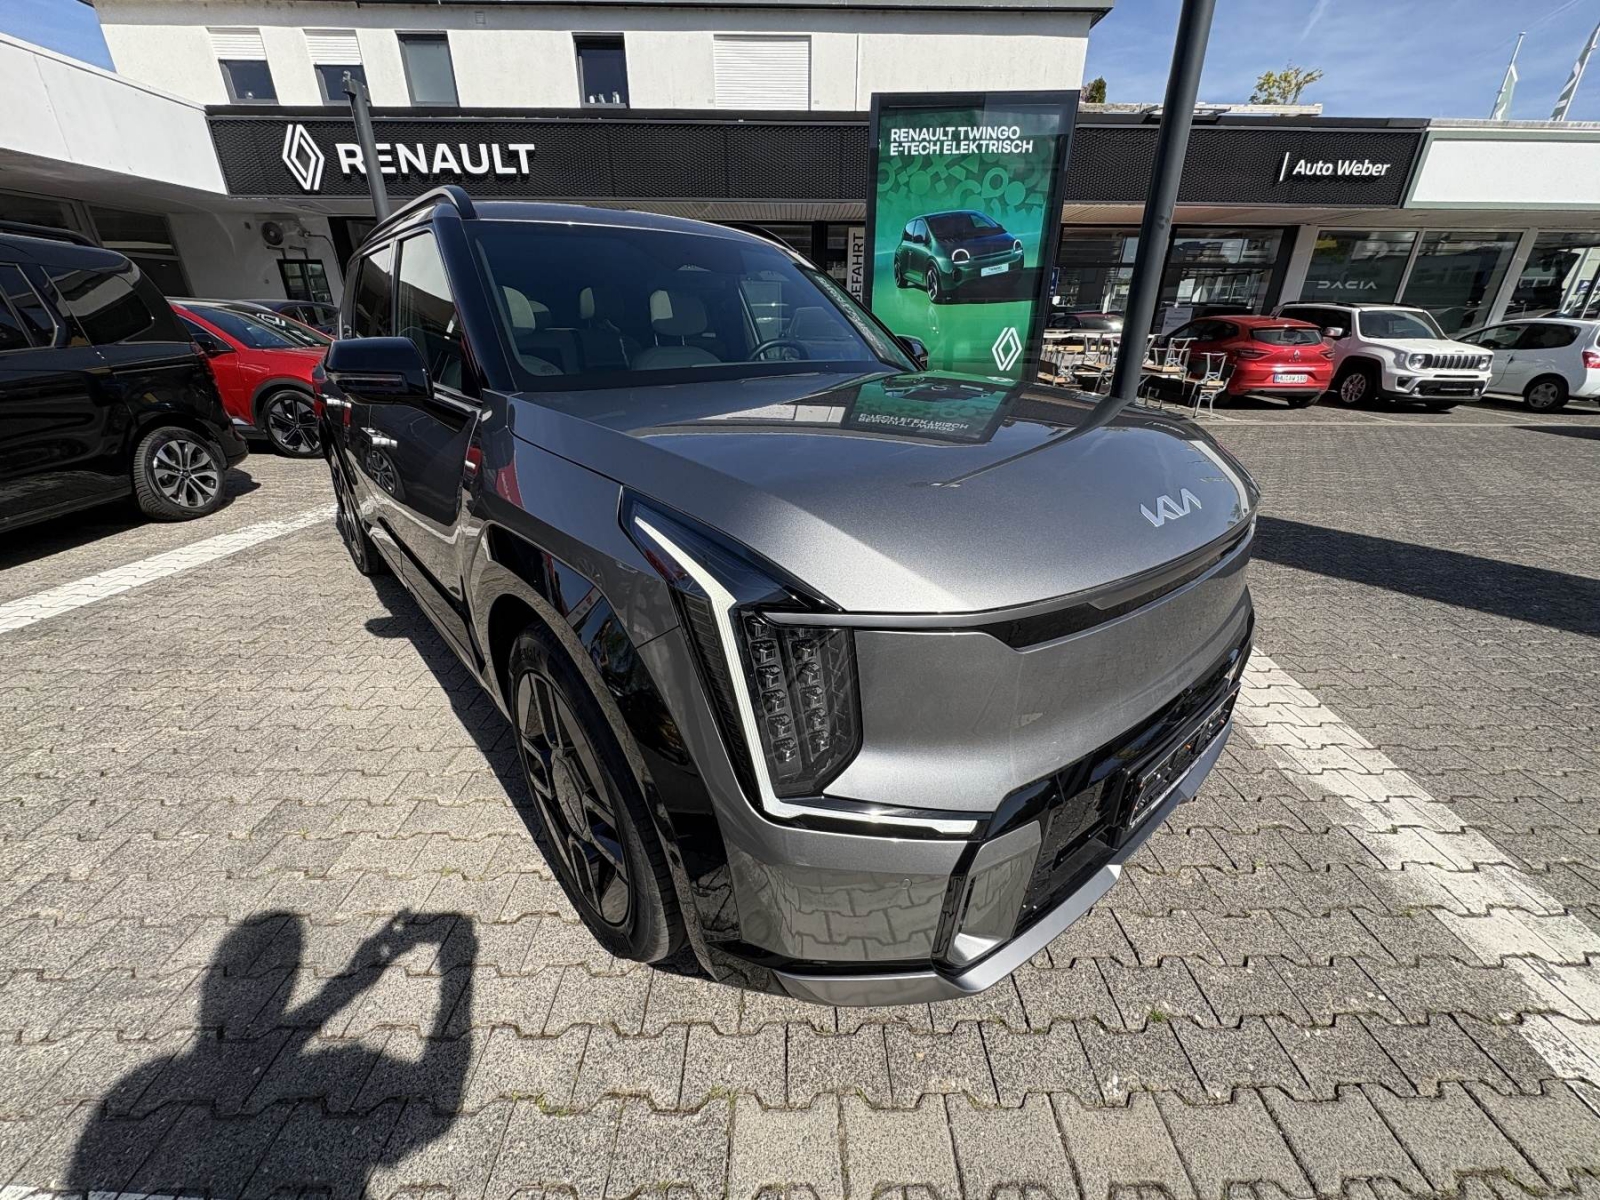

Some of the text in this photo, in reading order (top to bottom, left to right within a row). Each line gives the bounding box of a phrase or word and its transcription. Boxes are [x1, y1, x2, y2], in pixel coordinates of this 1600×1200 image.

[890, 126, 1020, 141] RENAULT TWINGO
[890, 140, 1034, 156] E-TECH ELEKTRISCH
[335, 143, 535, 174] RENAULT
[1292, 159, 1391, 176] Auto Weber
[1317, 281, 1378, 290] DACIA
[1140, 488, 1202, 528] KIA
